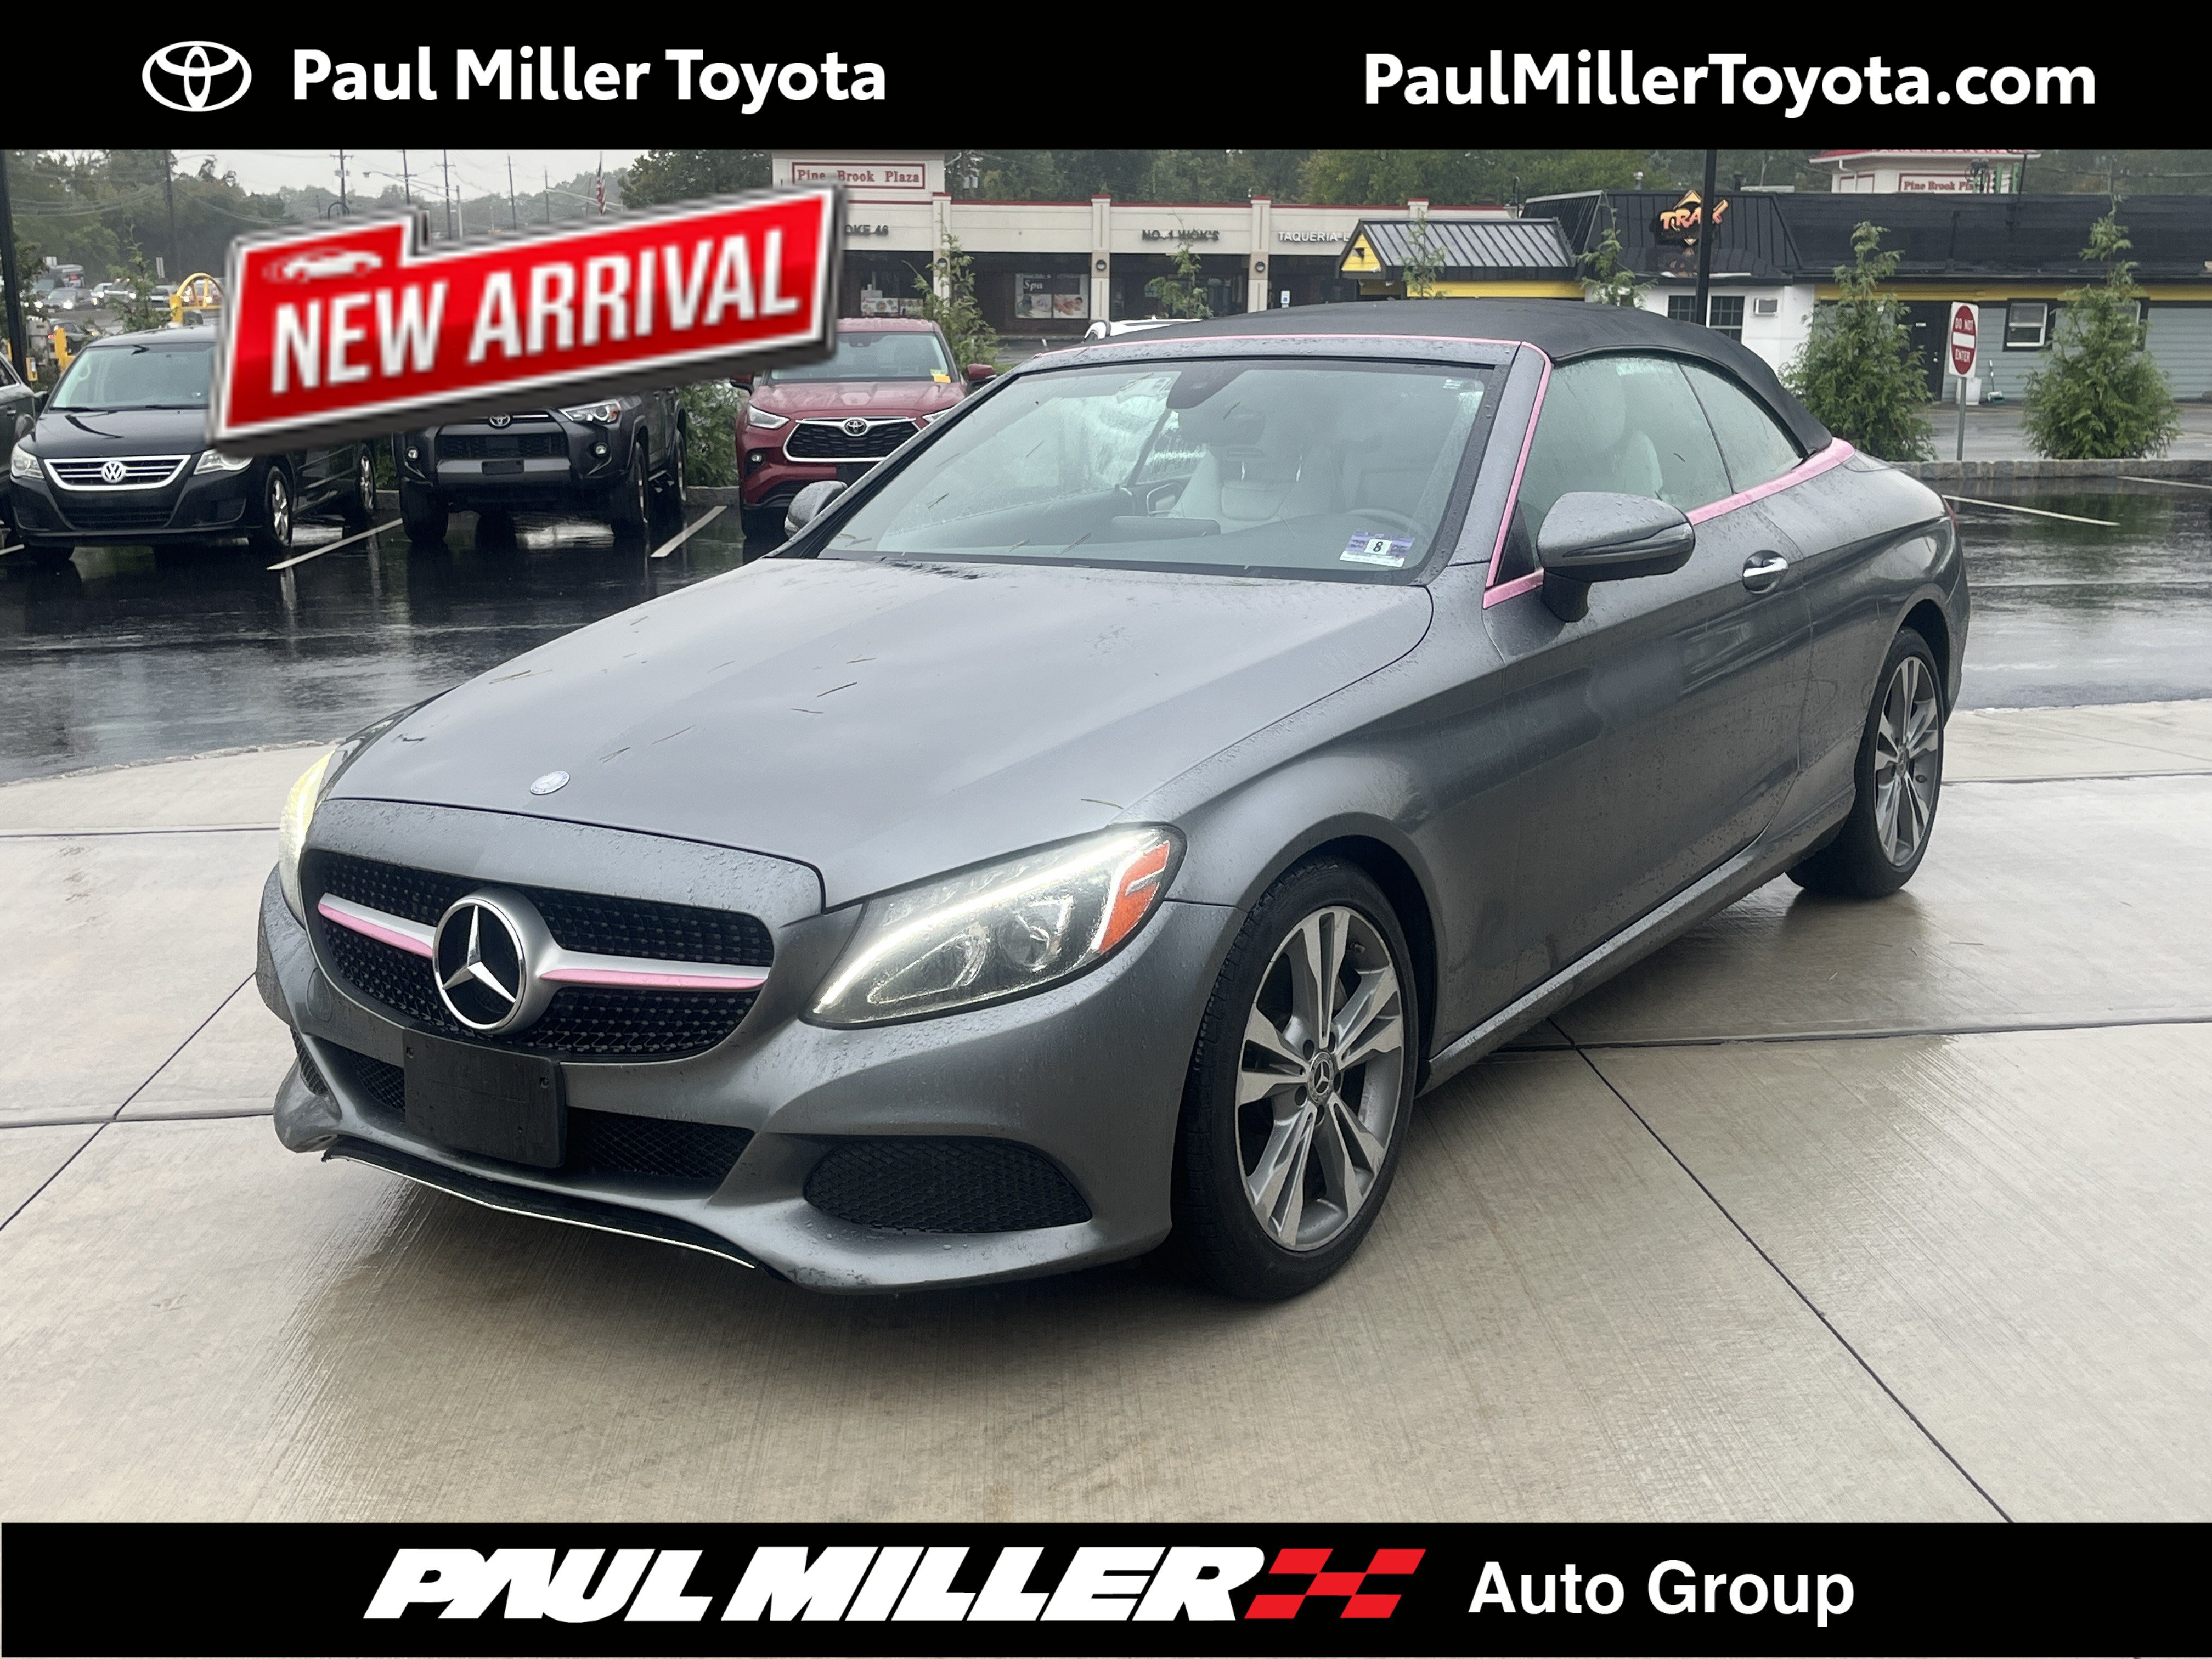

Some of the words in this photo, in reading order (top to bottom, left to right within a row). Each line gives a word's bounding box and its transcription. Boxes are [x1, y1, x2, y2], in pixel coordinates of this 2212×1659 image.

[797, 170, 826, 181] Pine
[837, 170, 875, 182] Brook
[885, 171, 919, 182] Plaza
[1904, 181, 1925, 190] Pine
[1278, 232, 1338, 241] TAQUERIA
[1344, 232, 1352, 241] L
[1023, 279, 1043, 291] Spa
[1955, 317, 1963, 329] DO
[1964, 319, 1974, 331] NOT
[1955, 348, 1971, 362] ENTER
[1373, 541, 1384, 552] 8
